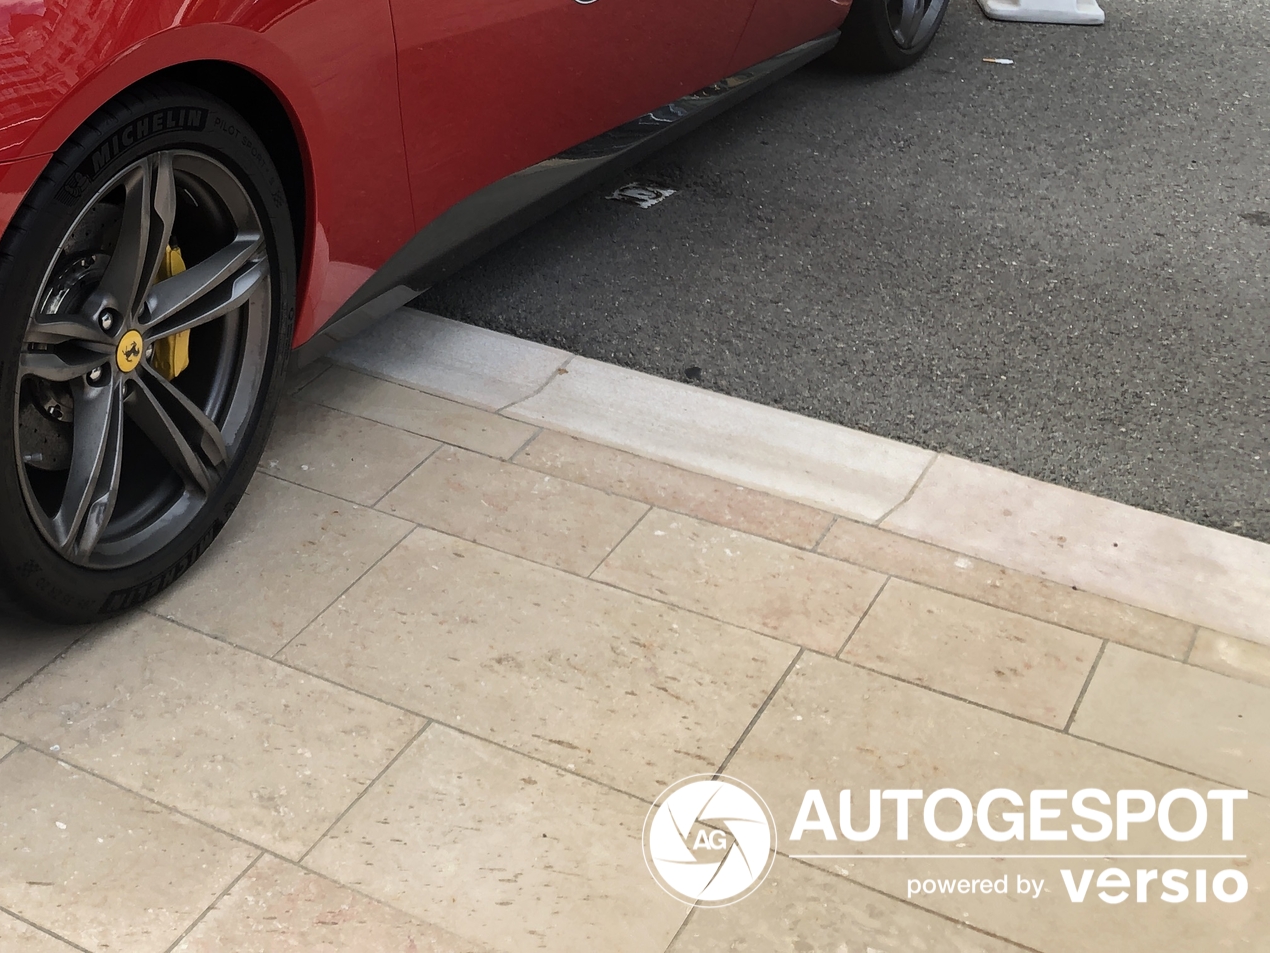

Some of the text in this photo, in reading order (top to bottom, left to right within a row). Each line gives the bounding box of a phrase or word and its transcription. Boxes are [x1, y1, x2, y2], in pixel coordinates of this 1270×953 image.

[91, 109, 267, 174] MICHELIN PILOT SPORT
